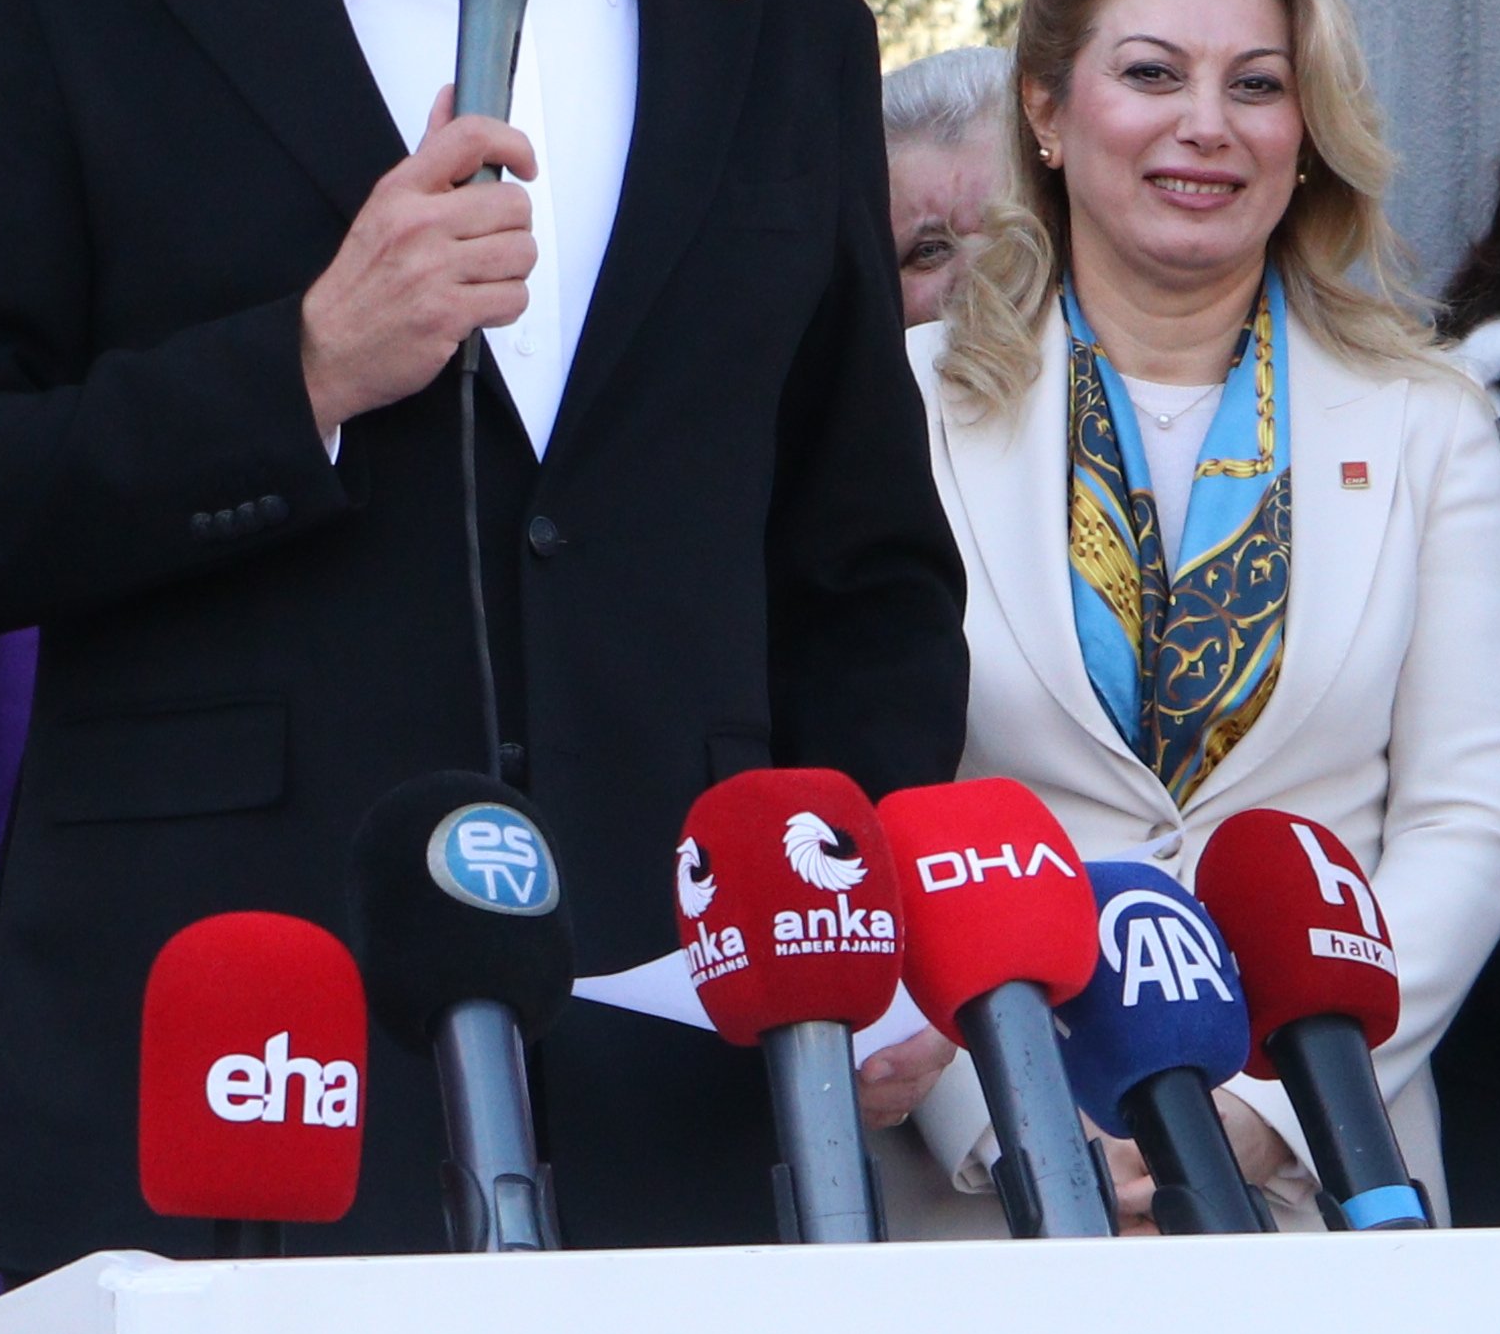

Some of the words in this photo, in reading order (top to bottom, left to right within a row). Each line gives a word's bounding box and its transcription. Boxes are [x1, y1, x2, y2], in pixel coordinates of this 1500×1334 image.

[468, 863, 537, 904] TV
[916, 842, 1077, 893] DHA
[773, 893, 895, 941] anka
[775, 939, 836, 956] HABER
[839, 940, 896, 954] AJANSI
[1122, 917, 1235, 1007] AA
[206, 1030, 359, 1128] eha
